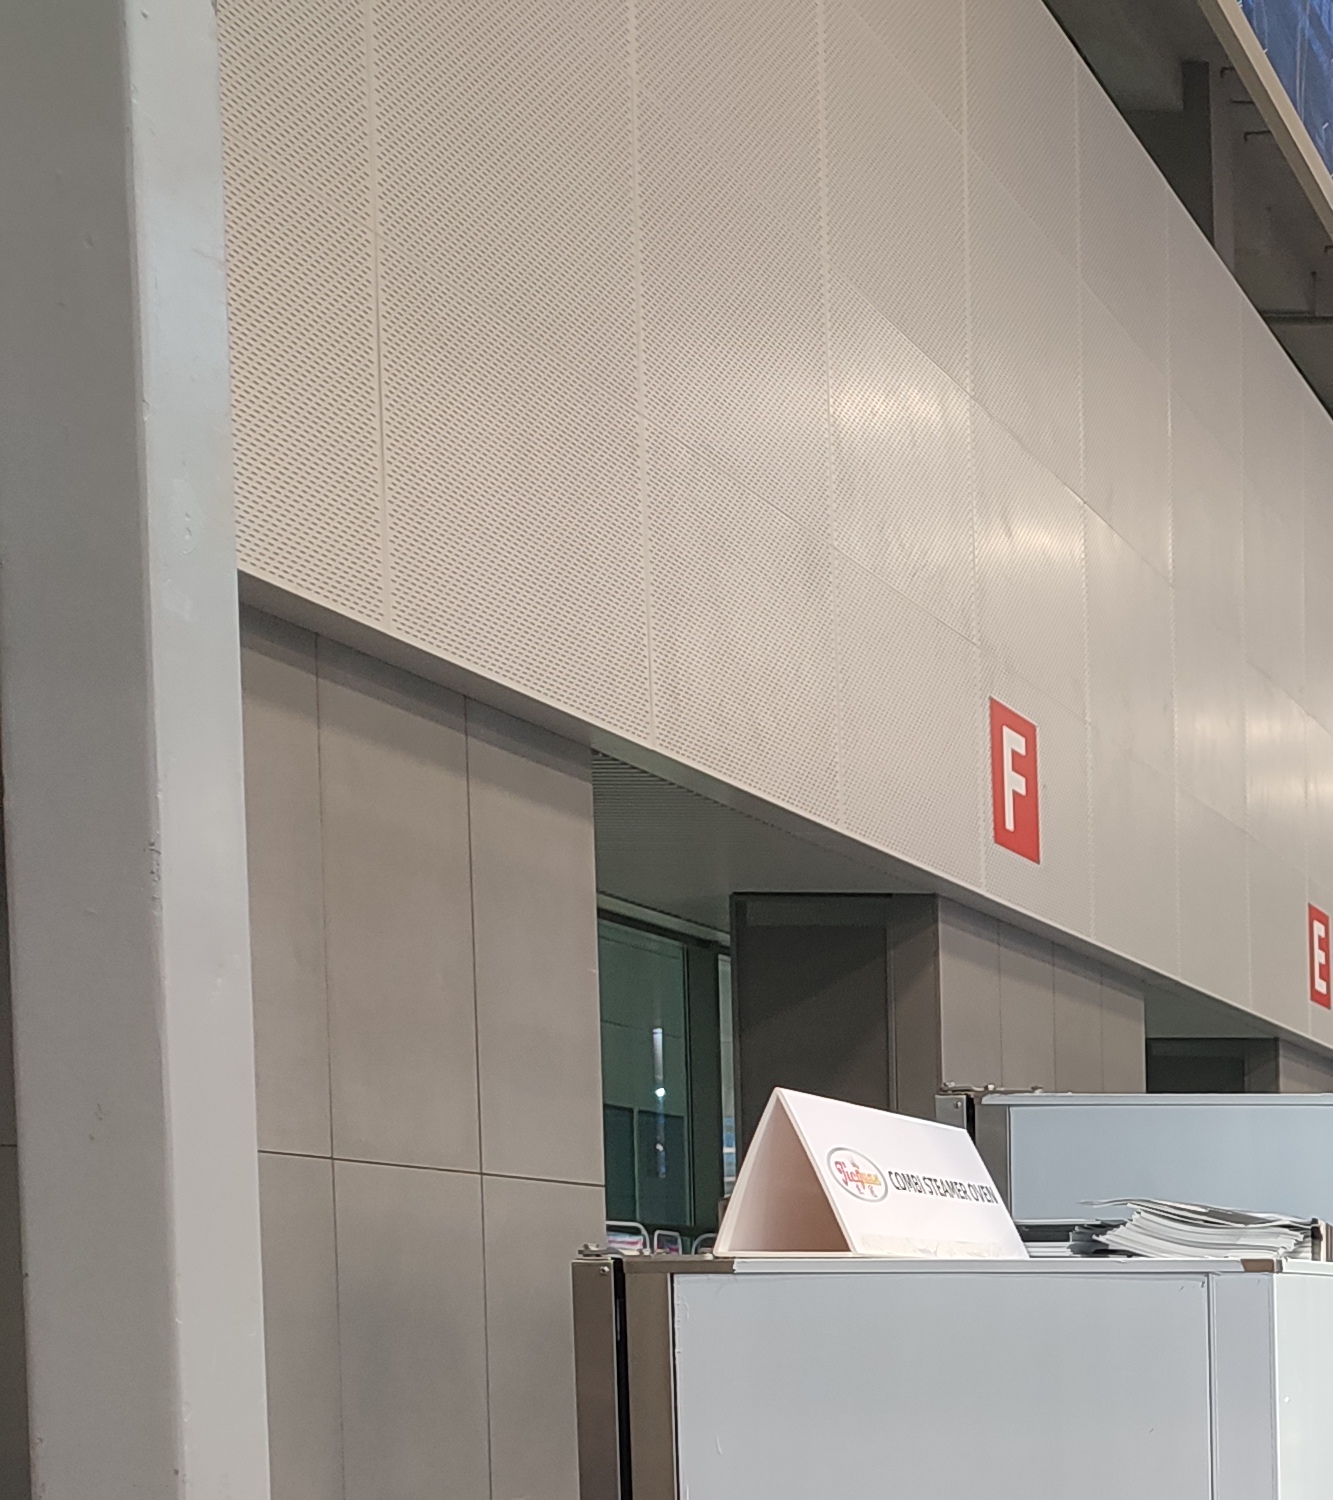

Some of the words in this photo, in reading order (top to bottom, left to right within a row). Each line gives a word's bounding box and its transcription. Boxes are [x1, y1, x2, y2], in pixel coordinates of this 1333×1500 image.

[1001, 724, 1027, 832] F
[1312, 919, 1328, 995] E
[888, 1170, 925, 1195] COMBI
[924, 1176, 970, 1201] STEAMER
[969, 1183, 999, 1205] OVEN
